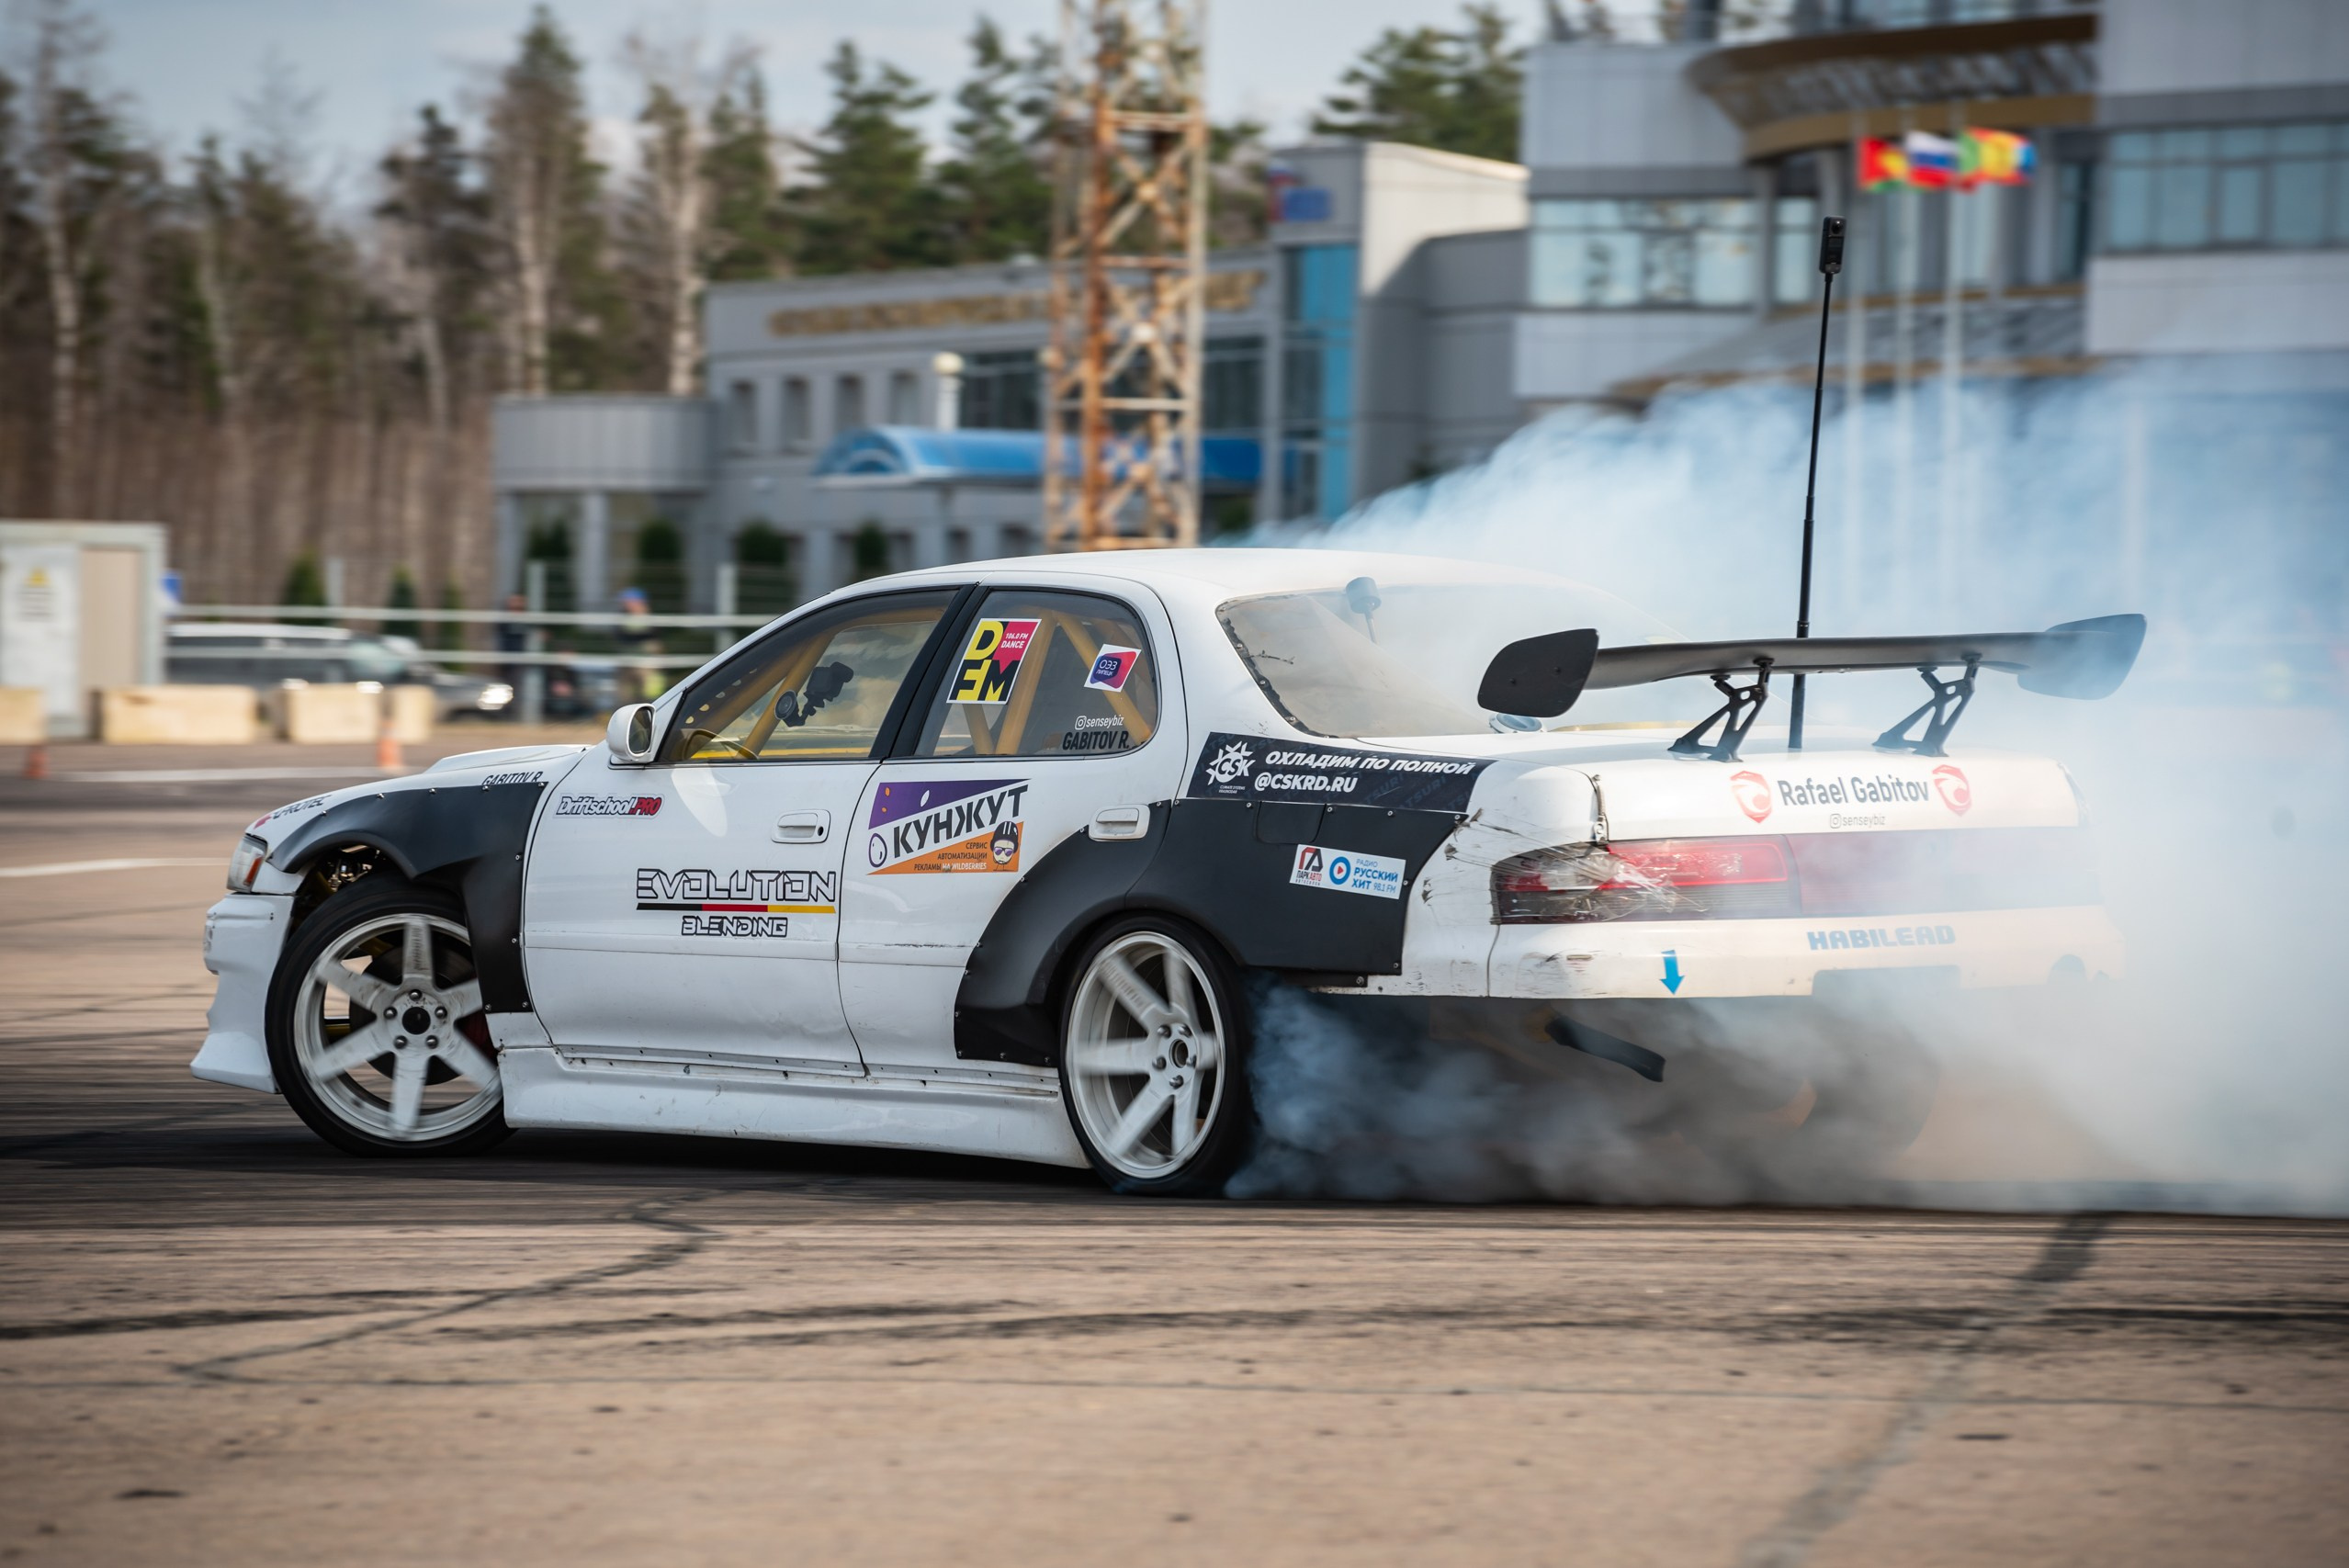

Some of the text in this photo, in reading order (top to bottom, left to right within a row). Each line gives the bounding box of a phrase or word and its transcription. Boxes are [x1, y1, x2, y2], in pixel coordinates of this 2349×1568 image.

[1000, 640, 1025, 649] DANCE
[1086, 715, 1124, 728] senseybiz
[1062, 730, 1130, 750] GABITOV R.
[1265, 751, 1476, 775] ОХЛАДИМ ПО ПОЛНОЙ
[1254, 773, 1358, 793] @CSKRD.RU
[1777, 774, 1929, 807] Rafael Gabitov
[893, 784, 1029, 859] КУНЖУТ
[1842, 813, 1886, 828] senseybiz
[966, 841, 988, 850] СЕРВИС
[937, 852, 988, 862] АВТОМАТИЗАЦИИ
[1356, 858, 1378, 868] РАДИО
[1353, 866, 1398, 883] РУССКИЙ
[637, 868, 836, 902] EVOLUTION
[1351, 878, 1396, 893] ХИТ 98.1 FM
[682, 916, 788, 937] BLENDING
[1806, 925, 1956, 951] HABILEAD
